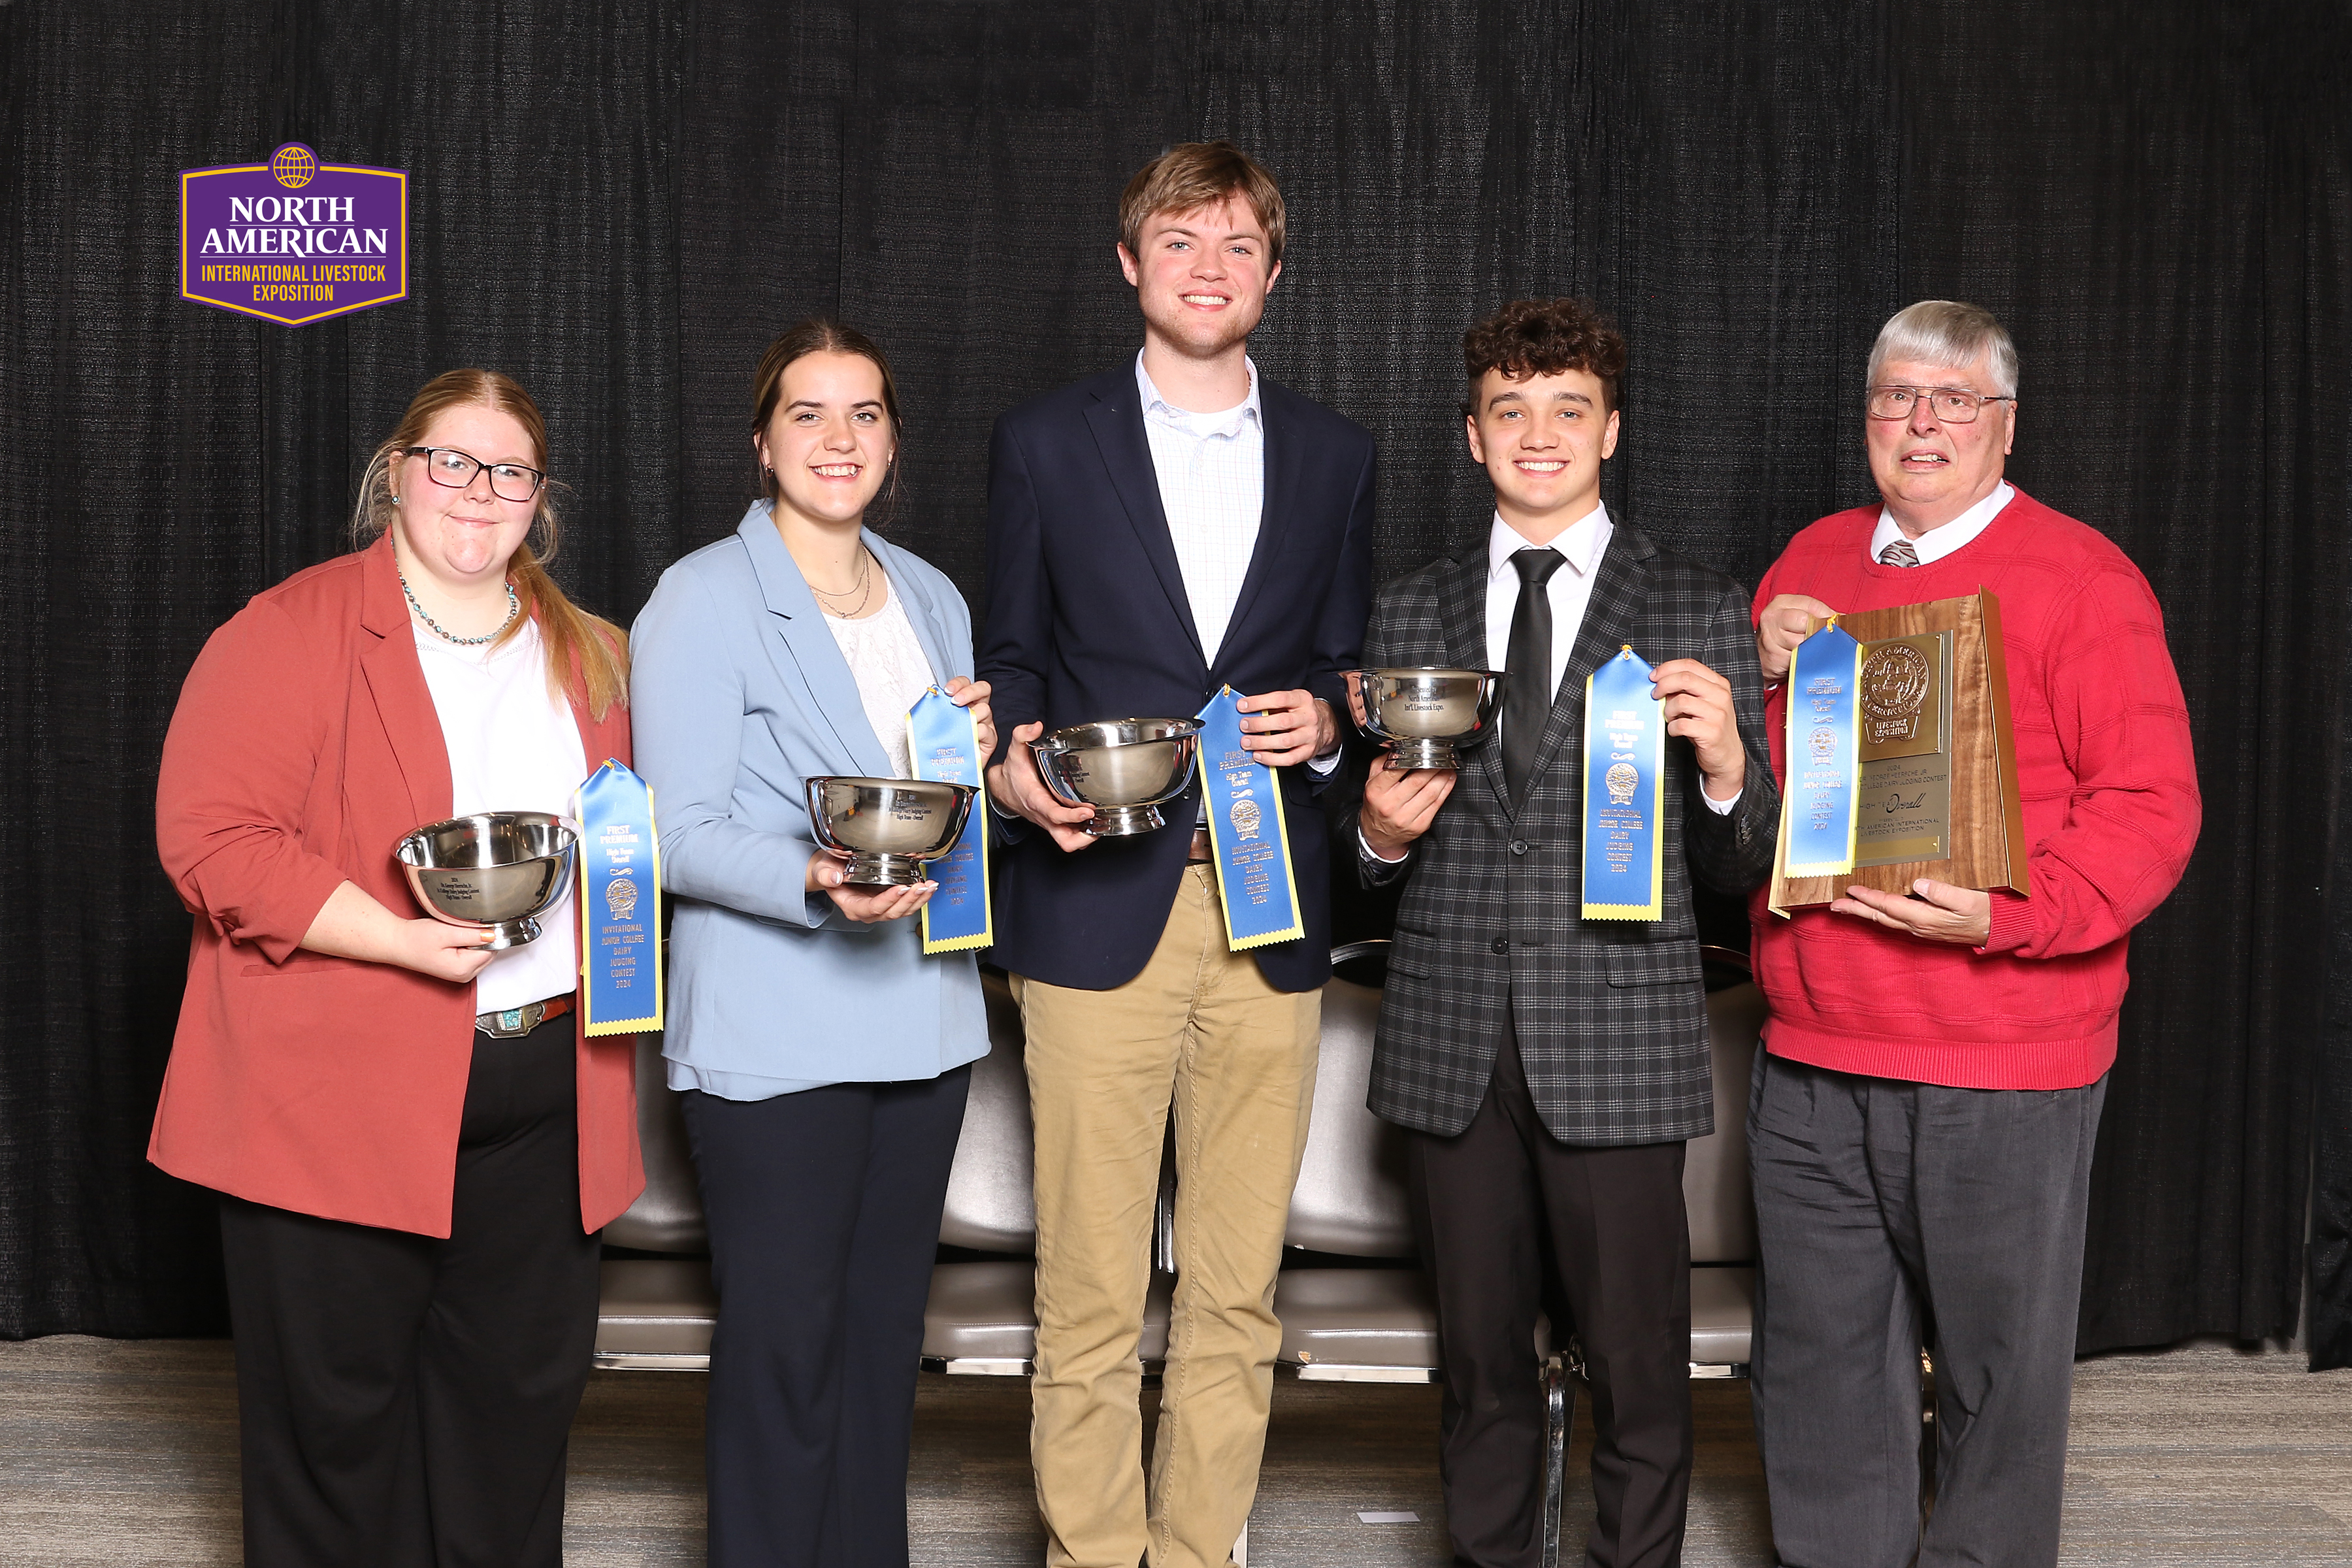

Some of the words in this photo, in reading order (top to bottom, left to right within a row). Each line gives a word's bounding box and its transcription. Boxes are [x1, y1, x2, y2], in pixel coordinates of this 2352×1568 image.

[1886, 646, 1927, 680] AMERICAN
[1814, 678, 1835, 687] FIRST
[1806, 686, 1842, 695] PREMIUM
[1433, 704, 1445, 712] Expo.
[1875, 718, 1908, 730] LIVESTOCK
[1874, 726, 1909, 738] EXPOSITION
[936, 747, 957, 757] FIRST
[1224, 750, 1247, 760] FIRST
[930, 757, 965, 766] PREMIUM
[1899, 777, 1922, 786] JUDGING
[1923, 774, 1947, 783] CONTEST
[1810, 802, 1834, 810] JUDGING
[1886, 792, 1927, 814] Overall
[1810, 811, 1833, 821] CONTEST
[1814, 822, 1828, 830] 2024
[1895, 818, 1940, 827] INTERNATIONAL
[606, 825, 630, 835] FIRST
[1891, 825, 1925, 834] EXPOSITION
[600, 834, 639, 845] PREMIUM
[1252, 894, 1267, 905] 2024
[602, 924, 643, 934] INVITATIONAL
[602, 936, 621, 946] JUNIOR
[622, 934, 645, 944] COLLEGE
[613, 946, 632, 955] DAIRY
[610, 957, 636, 967] JUDGING
[611, 968, 636, 978] CONTEST
[615, 979, 632, 989] 2024
